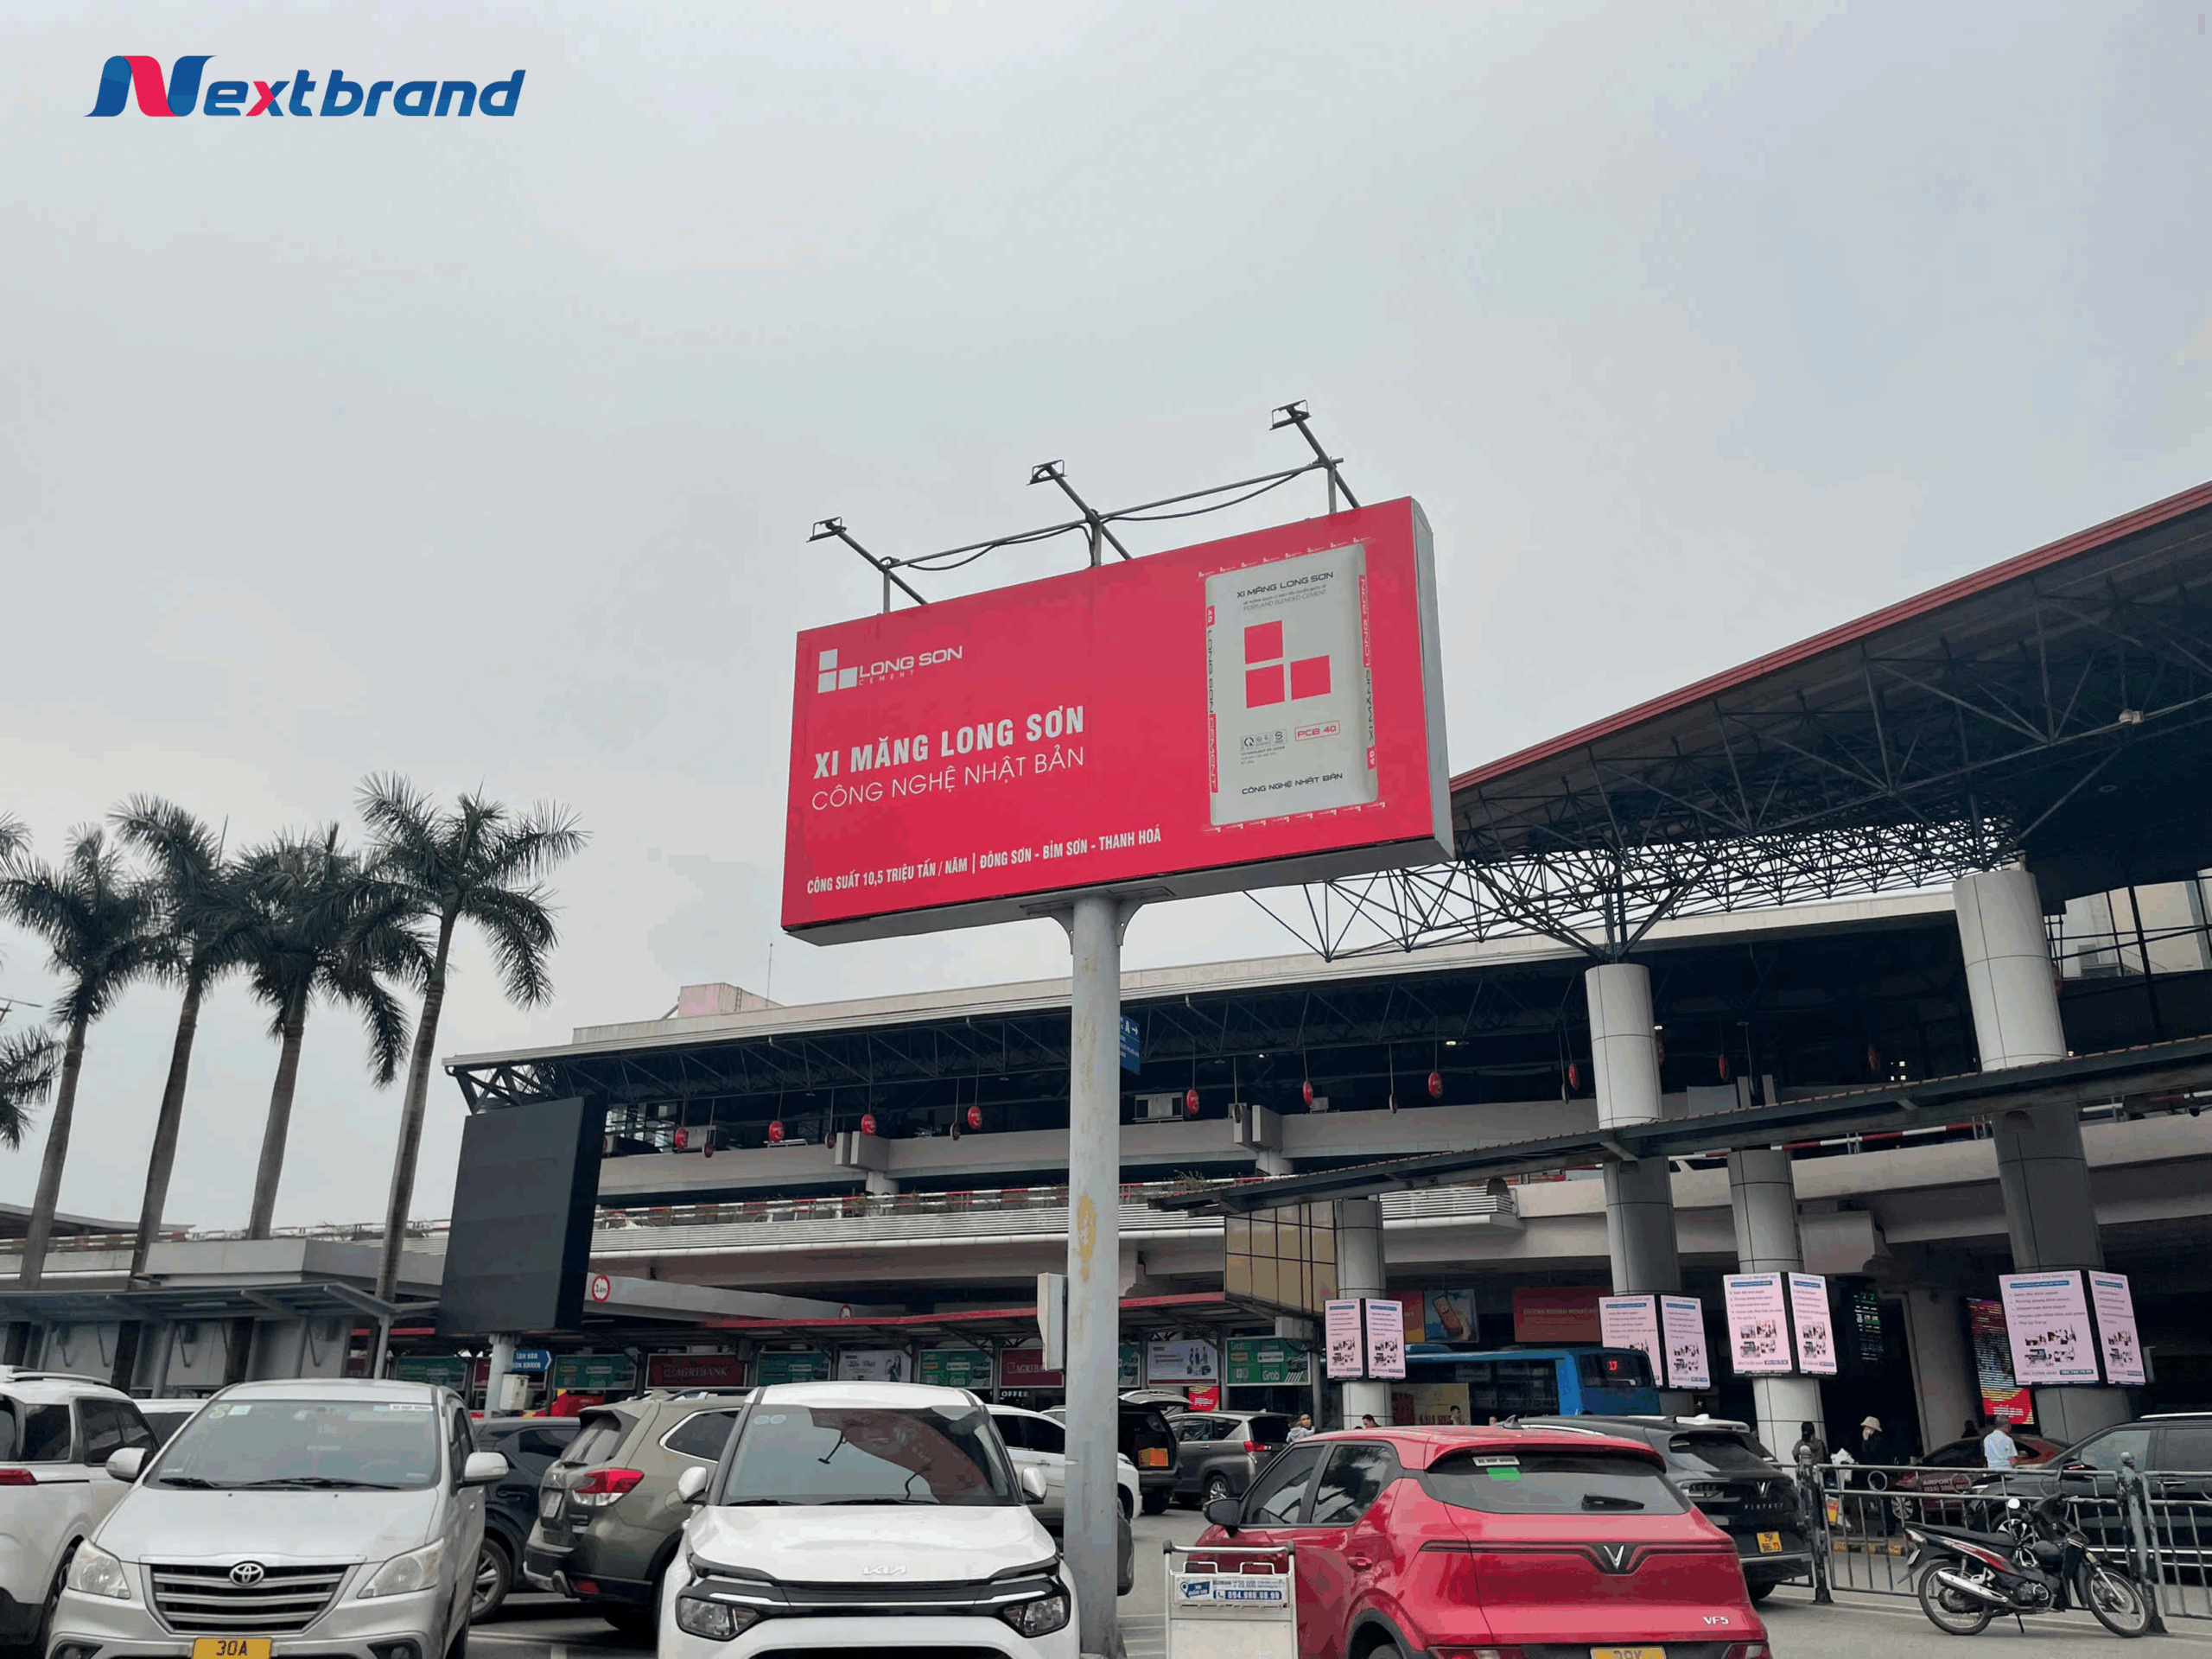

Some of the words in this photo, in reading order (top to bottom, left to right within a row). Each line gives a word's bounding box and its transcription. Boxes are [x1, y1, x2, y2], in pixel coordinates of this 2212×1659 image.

[1236, 590, 1246, 599] XI
[1280, 577, 1309, 589] LONG
[1302, 589, 1327, 600] CEMENT
[859, 656, 915, 678] LONG
[859, 670, 914, 686] CEMENT
[1297, 728, 1320, 738] PCB
[813, 750, 839, 779] XI
[850, 735, 929, 774] MĂNG
[941, 719, 1014, 758] LONG
[1027, 705, 1084, 741] SƠN
[811, 782, 883, 810] CÔNG
[892, 766, 956, 798] NGHỆ
[965, 757, 1027, 785] NHẬT
[1035, 744, 1084, 774] BẢN
[1242, 785, 1267, 794] CÔNG
[1268, 779, 1292, 790] NGHỆ
[807, 876, 833, 894] CÔNG
[836, 869, 861, 891] SUẤT
[862, 870, 884, 887] 10,5
[887, 863, 915, 884] TRIỆU
[917, 858, 937, 878] TẤN
[944, 856, 968, 874] NĂM
[980, 850, 1007, 868] ĐÔNG
[1011, 847, 1032, 864] SƠN
[1066, 837, 1088, 855] SƠN
[1099, 832, 1135, 850] THANH
[1138, 824, 1161, 845] HOÁ
[1262, 1370, 1281, 1381] Grab
[863, 1565, 906, 1574] KIA
[1703, 1616, 1730, 1624] VF5
[216, 1640, 248, 1656] 30A
